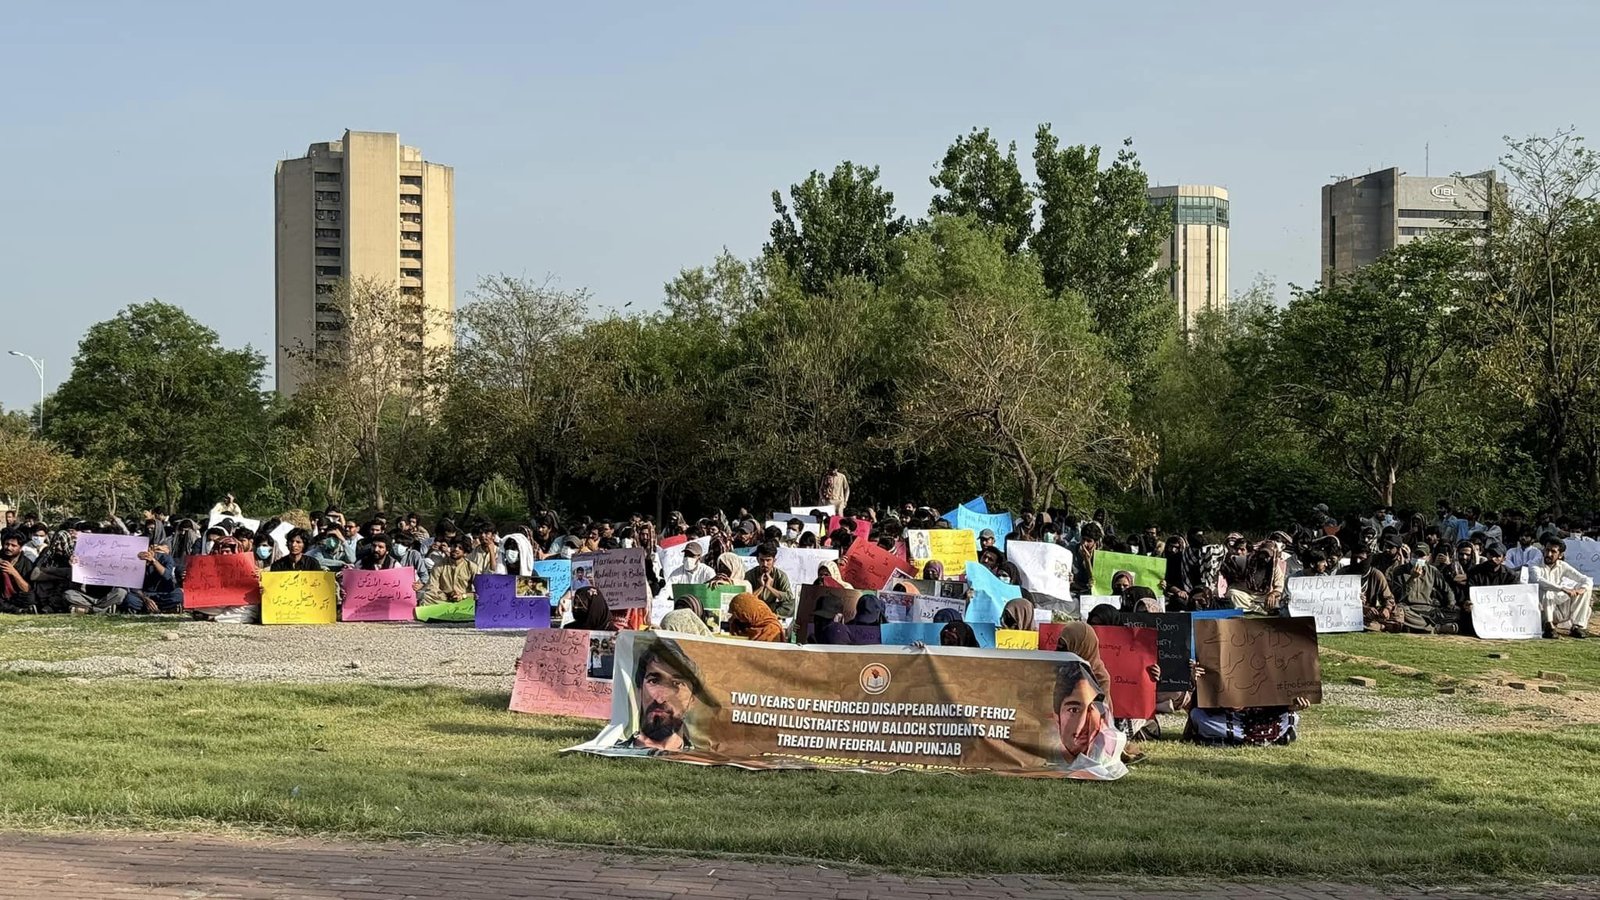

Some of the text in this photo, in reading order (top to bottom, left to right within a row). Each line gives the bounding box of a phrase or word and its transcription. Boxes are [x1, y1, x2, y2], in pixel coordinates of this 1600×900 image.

[730, 691, 1017, 721] TWO YEARS OF ENFORCED DISAPPEARANCE OF FEROZ
[731, 709, 1011, 739] BALOCH ILLUSTRATES HOW BALOCH STUDENTS ARE
[776, 733, 962, 756] TREATED IN FEDERAL AND PUNJAB
